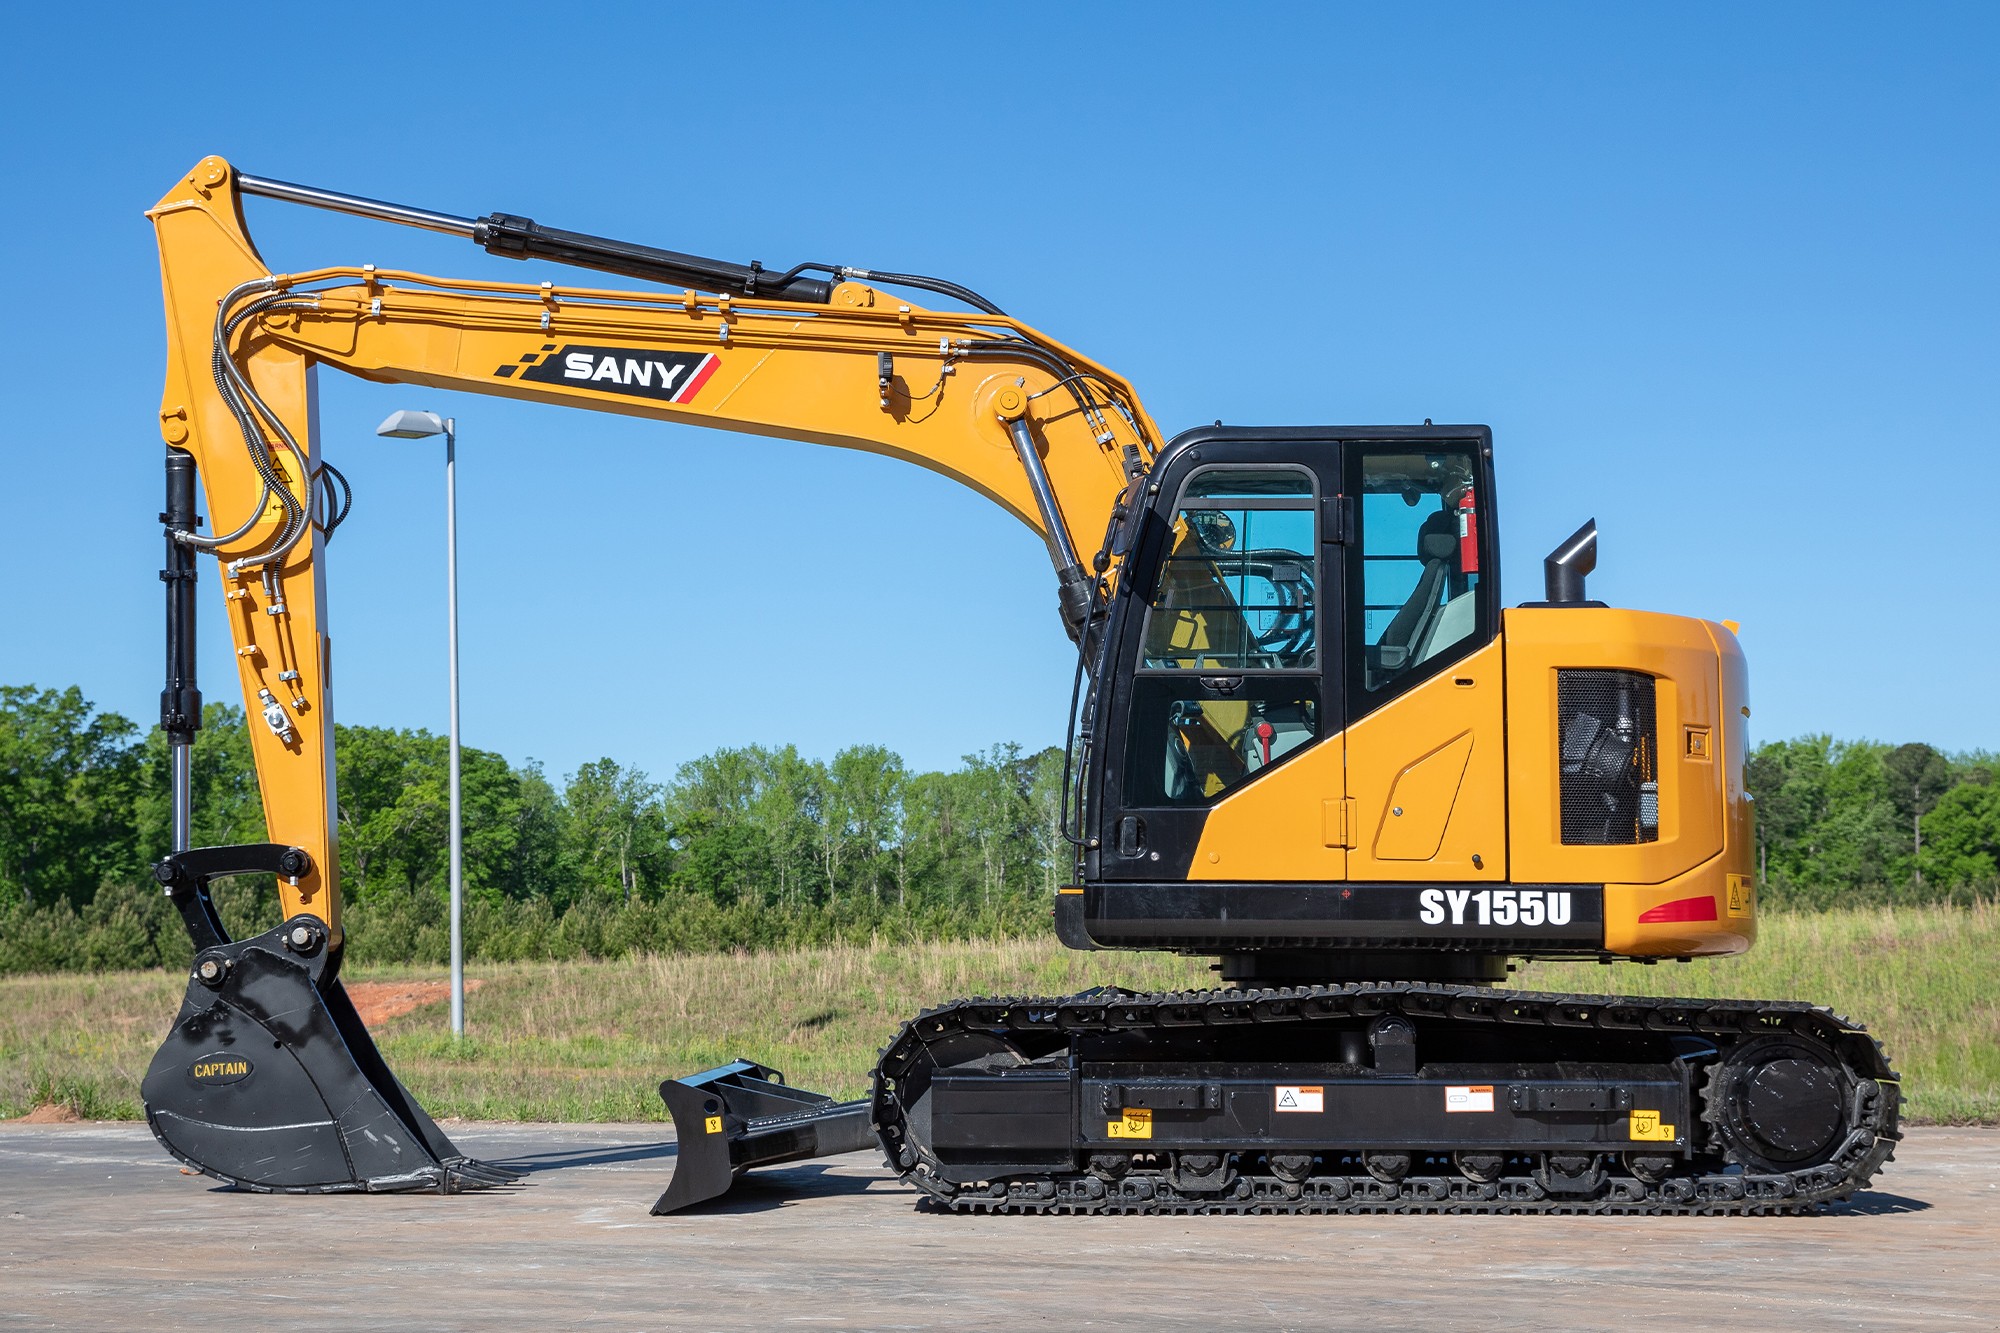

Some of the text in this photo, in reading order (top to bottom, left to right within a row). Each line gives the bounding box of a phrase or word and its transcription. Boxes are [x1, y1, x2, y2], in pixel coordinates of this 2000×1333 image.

[564, 352, 685, 389] SANY
[1420, 889, 1571, 926] SY155U
[194, 1062, 247, 1078] CAPTAIN
